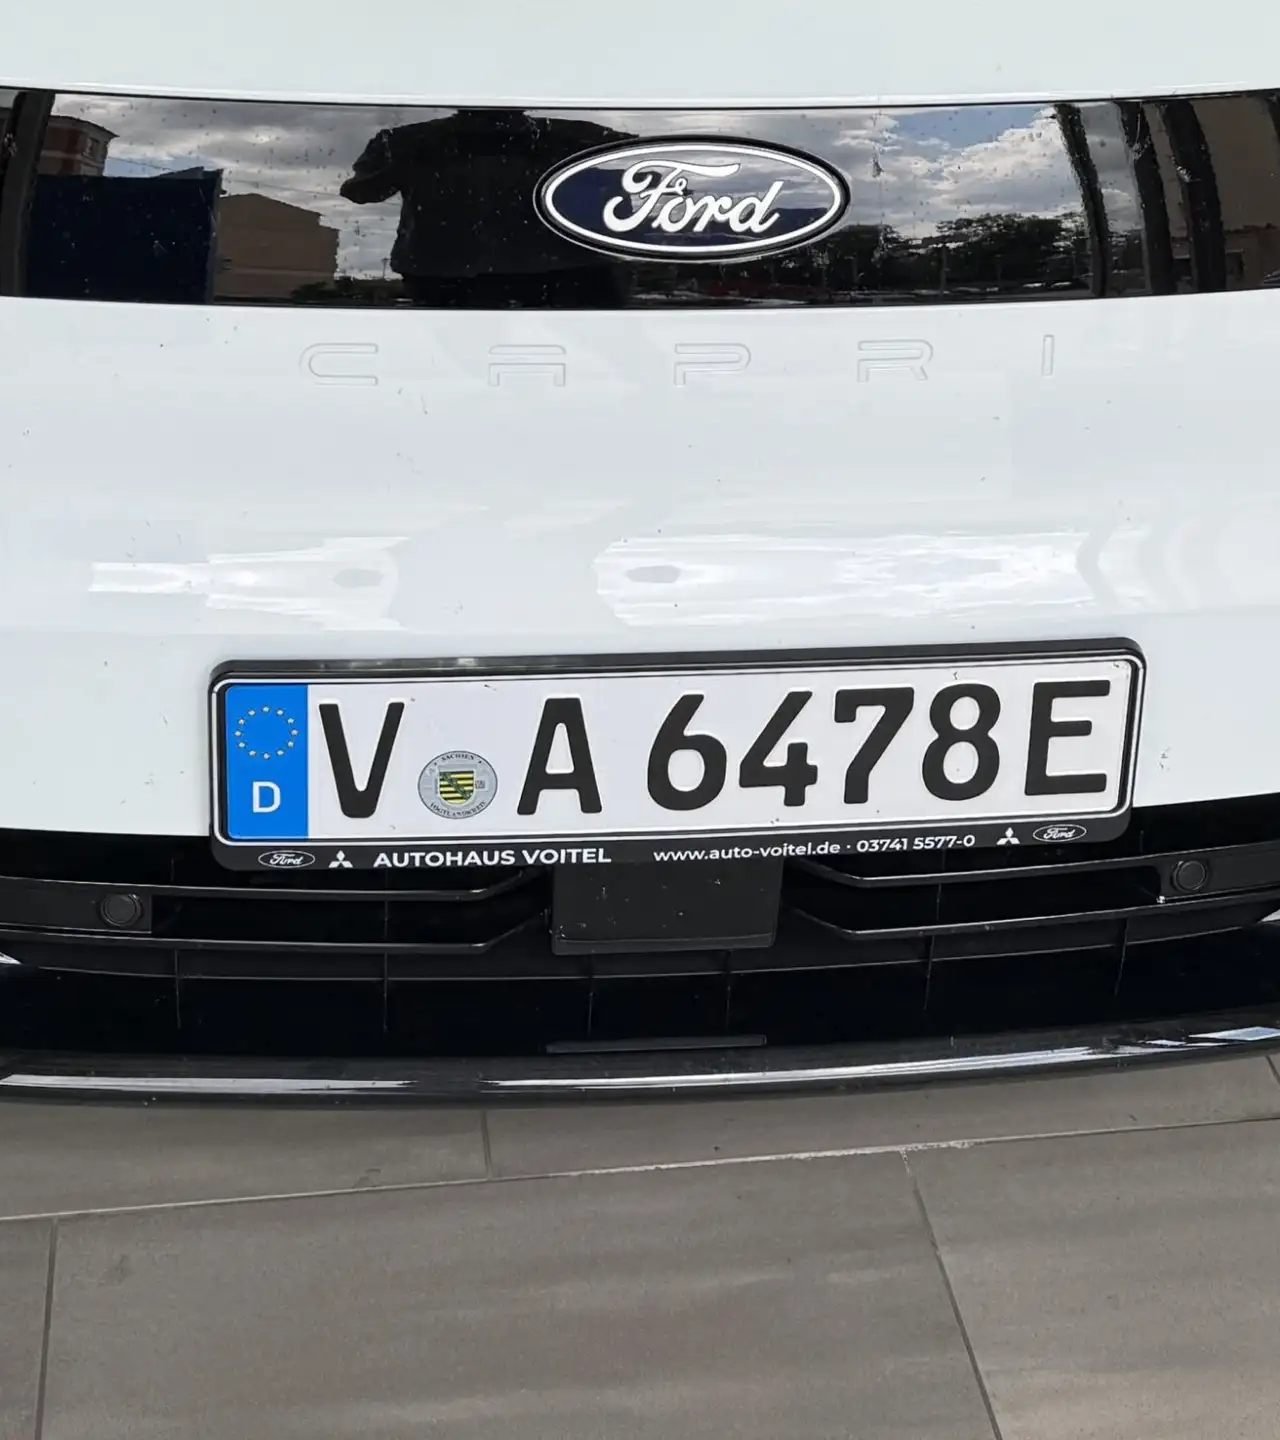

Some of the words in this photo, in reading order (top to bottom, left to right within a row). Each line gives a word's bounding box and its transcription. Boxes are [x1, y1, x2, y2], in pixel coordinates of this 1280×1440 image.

[603, 160, 787, 234] Ford
[299, 334, 1055, 388] CAPRI
[320, 701, 404, 819] V
[518, 697, 601, 815] A
[252, 782, 281, 813] D
[373, 850, 515, 867] AUTOHAUS
[522, 847, 612, 865] VOITEL
[653, 840, 840, 861] www.auto-voitel.de
[856, 838, 908, 853] 03741
[912, 834, 976, 850] 5577-0
